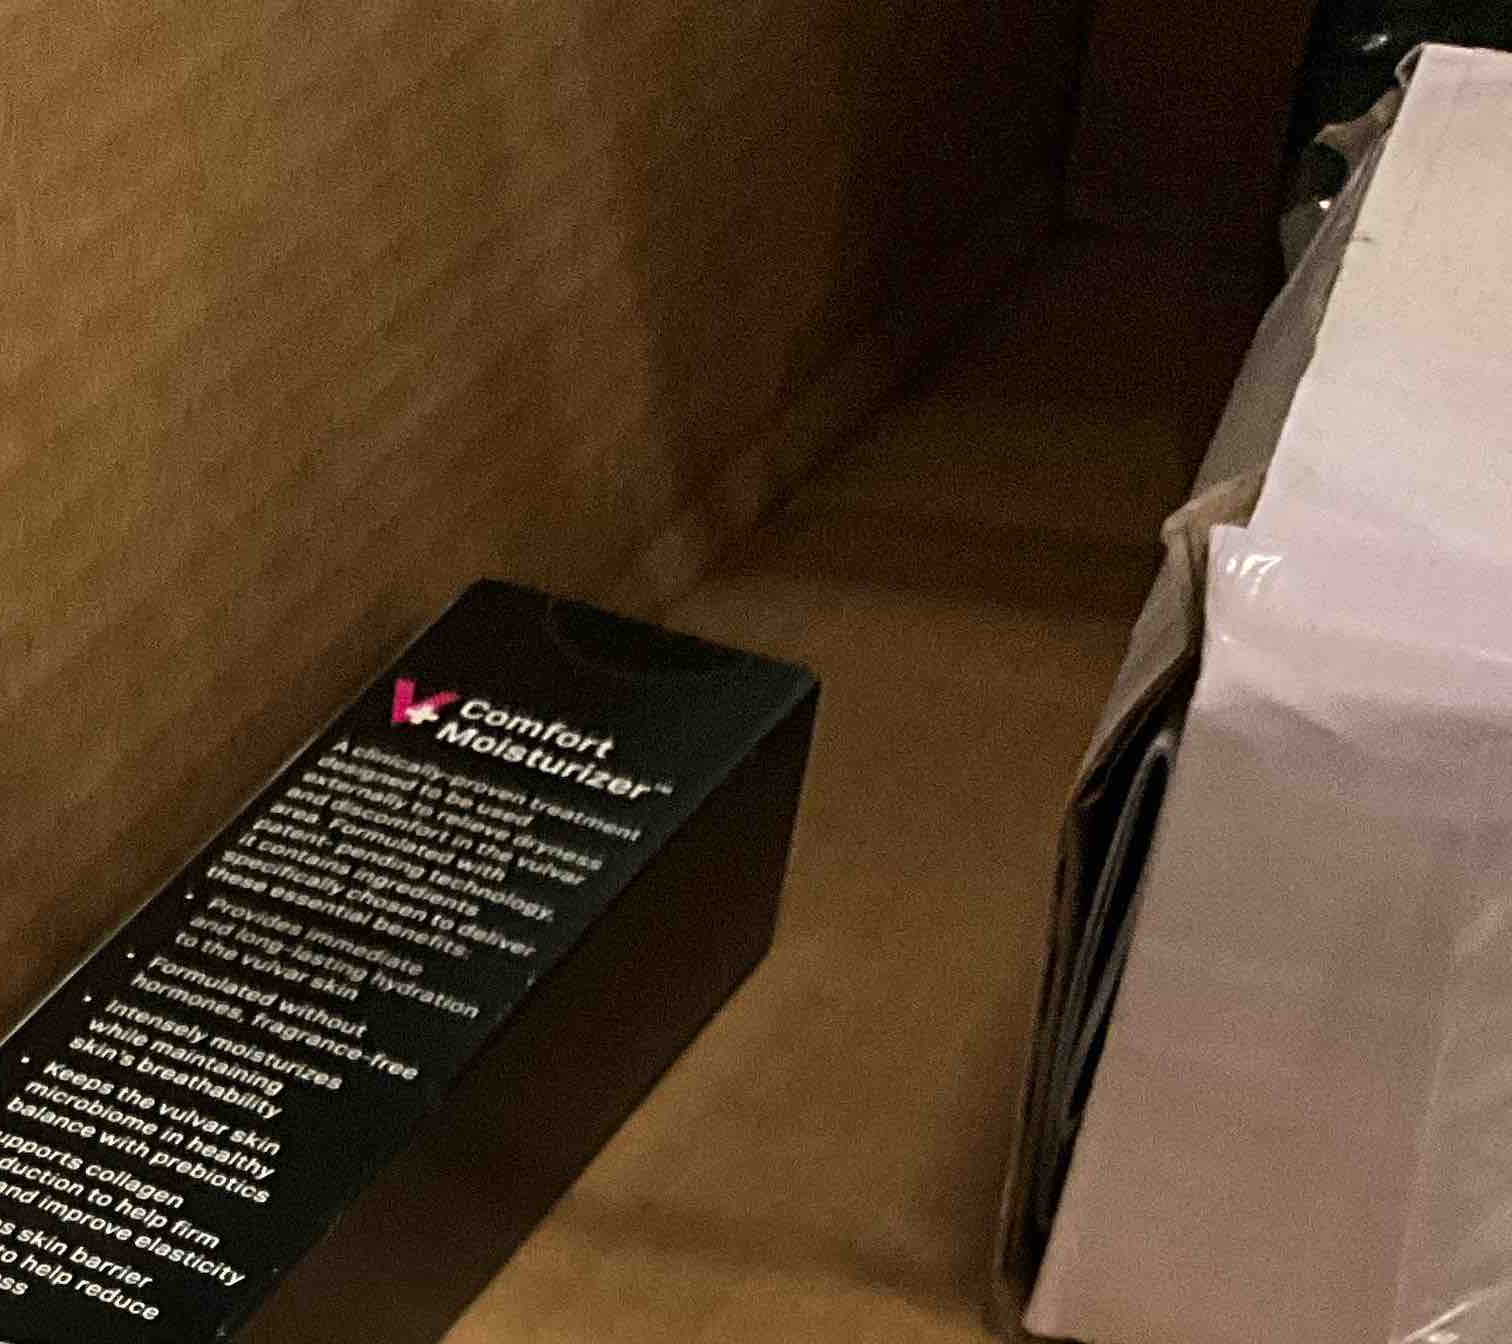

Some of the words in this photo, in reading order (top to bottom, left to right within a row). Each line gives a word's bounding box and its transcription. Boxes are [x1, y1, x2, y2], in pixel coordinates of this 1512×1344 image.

[458, 698, 615, 760] Comfort
[173, 930, 200, 949] to
[199, 938, 240, 962] the
[240, 952, 311, 984] vulvar
[308, 976, 360, 1002] skin
[188, 915, 237, 937] and
[233, 925, 370, 984] long-lasting
[369, 969, 481, 1020] hydration
[206, 896, 304, 938] Provides
[303, 926, 425, 977] immediate
[147, 954, 280, 1008] Formulated
[277, 998, 369, 1040] without
[67, 1036, 137, 1068] skin's
[135, 1055, 284, 1121] breathability
[87, 1017, 150, 1048] while
[148, 1039, 285, 1098] maintaining
[103, 998, 210, 1045] Intensely
[208, 1035, 344, 1091] moisturizes
[250, 1011, 420, 1082] fragrance-free
[23, 1080, 160, 1137] microbiome
[158, 1126, 185, 1146] in
[184, 1134, 276, 1181] healthy
[41, 1060, 116, 1096] Keeps
[115, 1085, 157, 1111] the
[158, 1102, 231, 1137] vulvar
[228, 1128, 282, 1157] skin
[5, 1095, 98, 1139] balance
[98, 1130, 151, 1159] with
[147, 1150, 271, 1204] prebiotics
[83, 1163, 186, 1210] collagen
[15, 1228, 69, 1257] skin
[68, 1245, 154, 1289] barrier
[36, 1194, 134, 1242] improve
[133, 1234, 247, 1288] elasticity
[86, 1187, 114, 1208] to
[113, 1196, 169, 1229] help
[169, 1218, 221, 1250] firm
[18, 1252, 74, 1287] help
[73, 1278, 161, 1321] reduce
